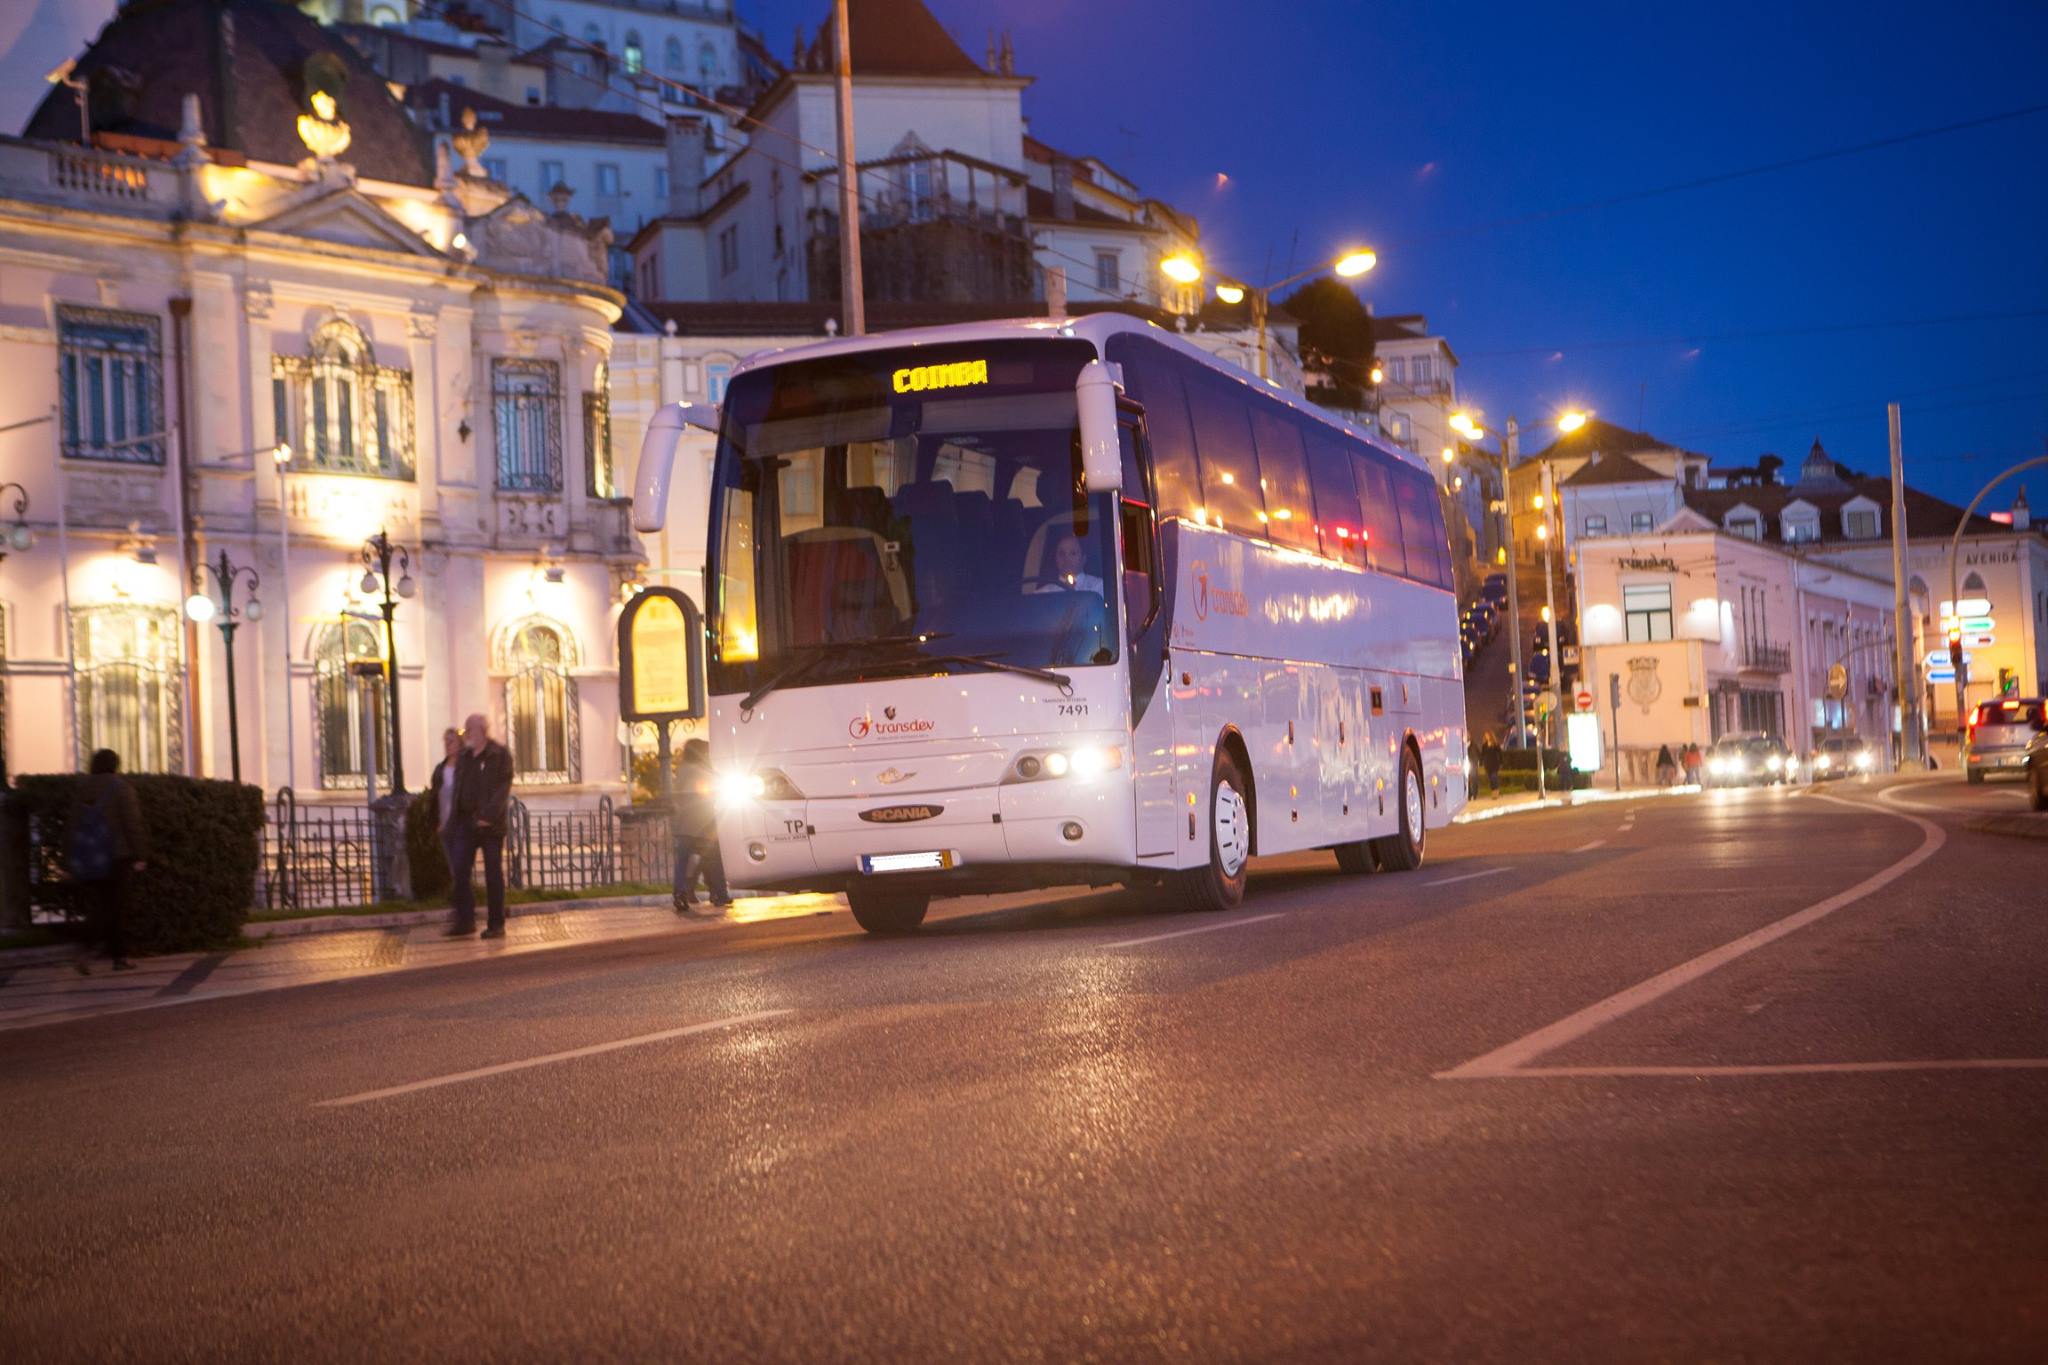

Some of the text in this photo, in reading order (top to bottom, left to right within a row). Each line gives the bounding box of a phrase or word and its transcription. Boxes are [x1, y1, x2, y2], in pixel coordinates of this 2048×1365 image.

[1058, 704, 1088, 716] 7491
[876, 719, 935, 734] transdev
[871, 806, 931, 821] SCANIA
[783, 820, 804, 834] TP
